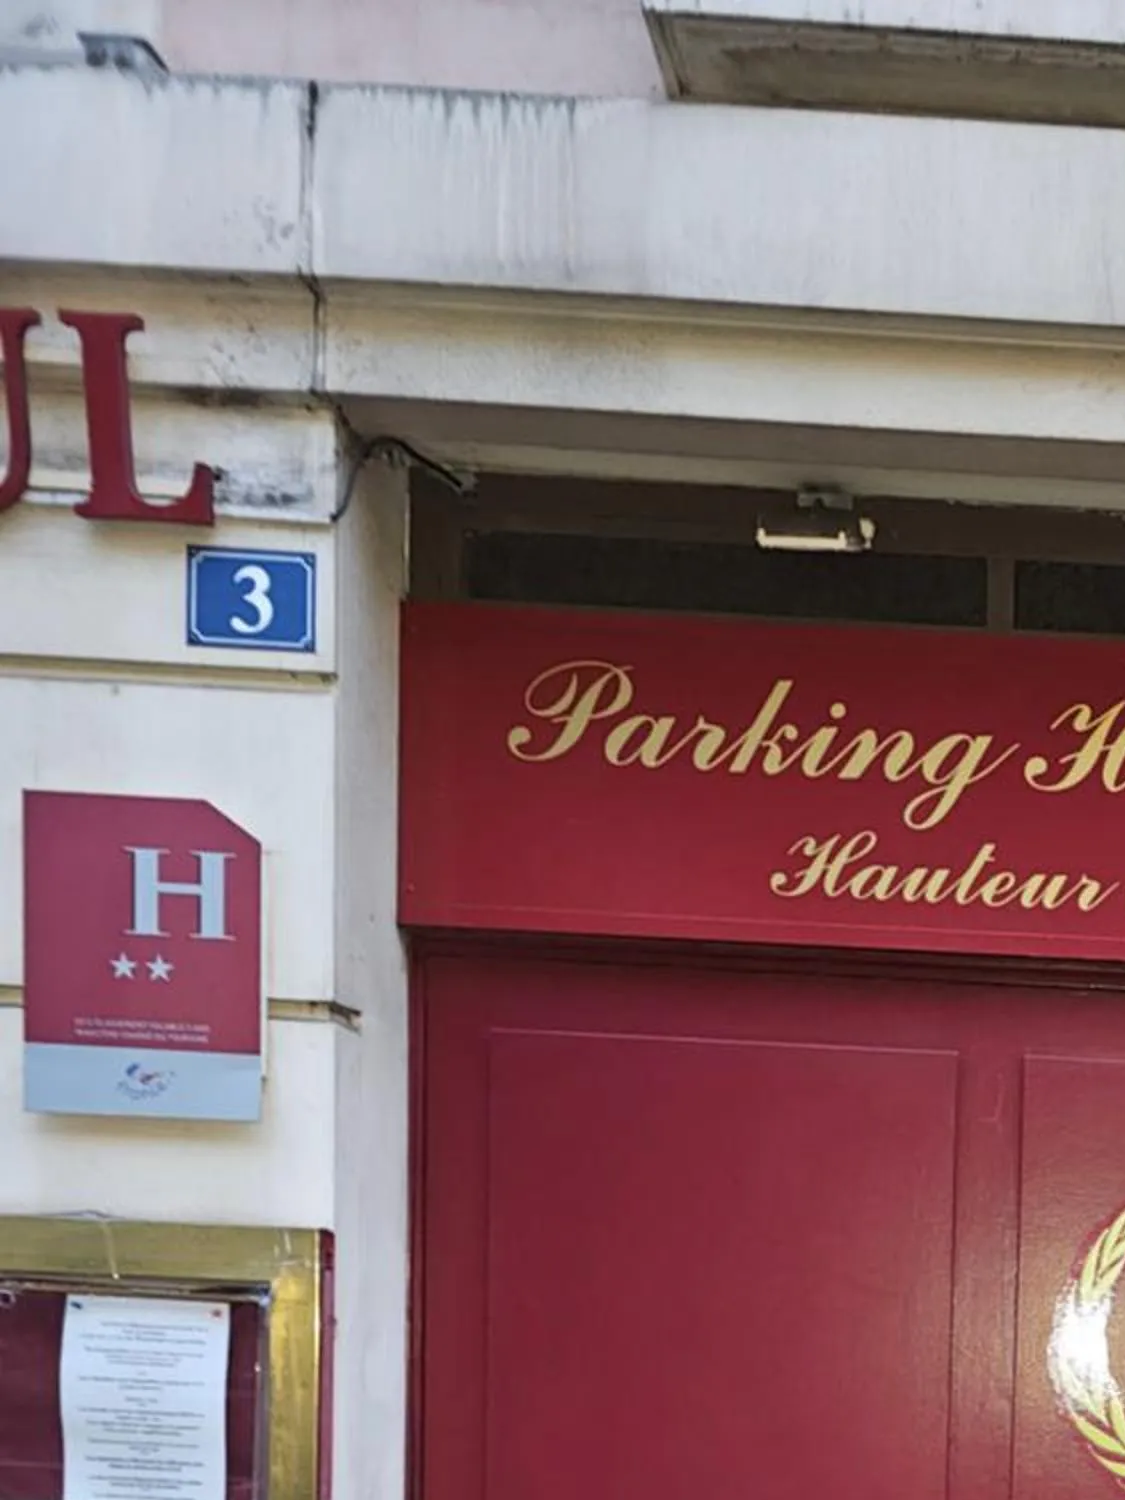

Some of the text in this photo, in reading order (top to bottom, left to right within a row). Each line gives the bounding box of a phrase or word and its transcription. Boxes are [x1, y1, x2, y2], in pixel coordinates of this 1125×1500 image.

[229, 564, 274, 634] 3
[507, 659, 1021, 830] Parking
[123, 845, 237, 941] H
[769, 830, 1120, 914] Hauteur
